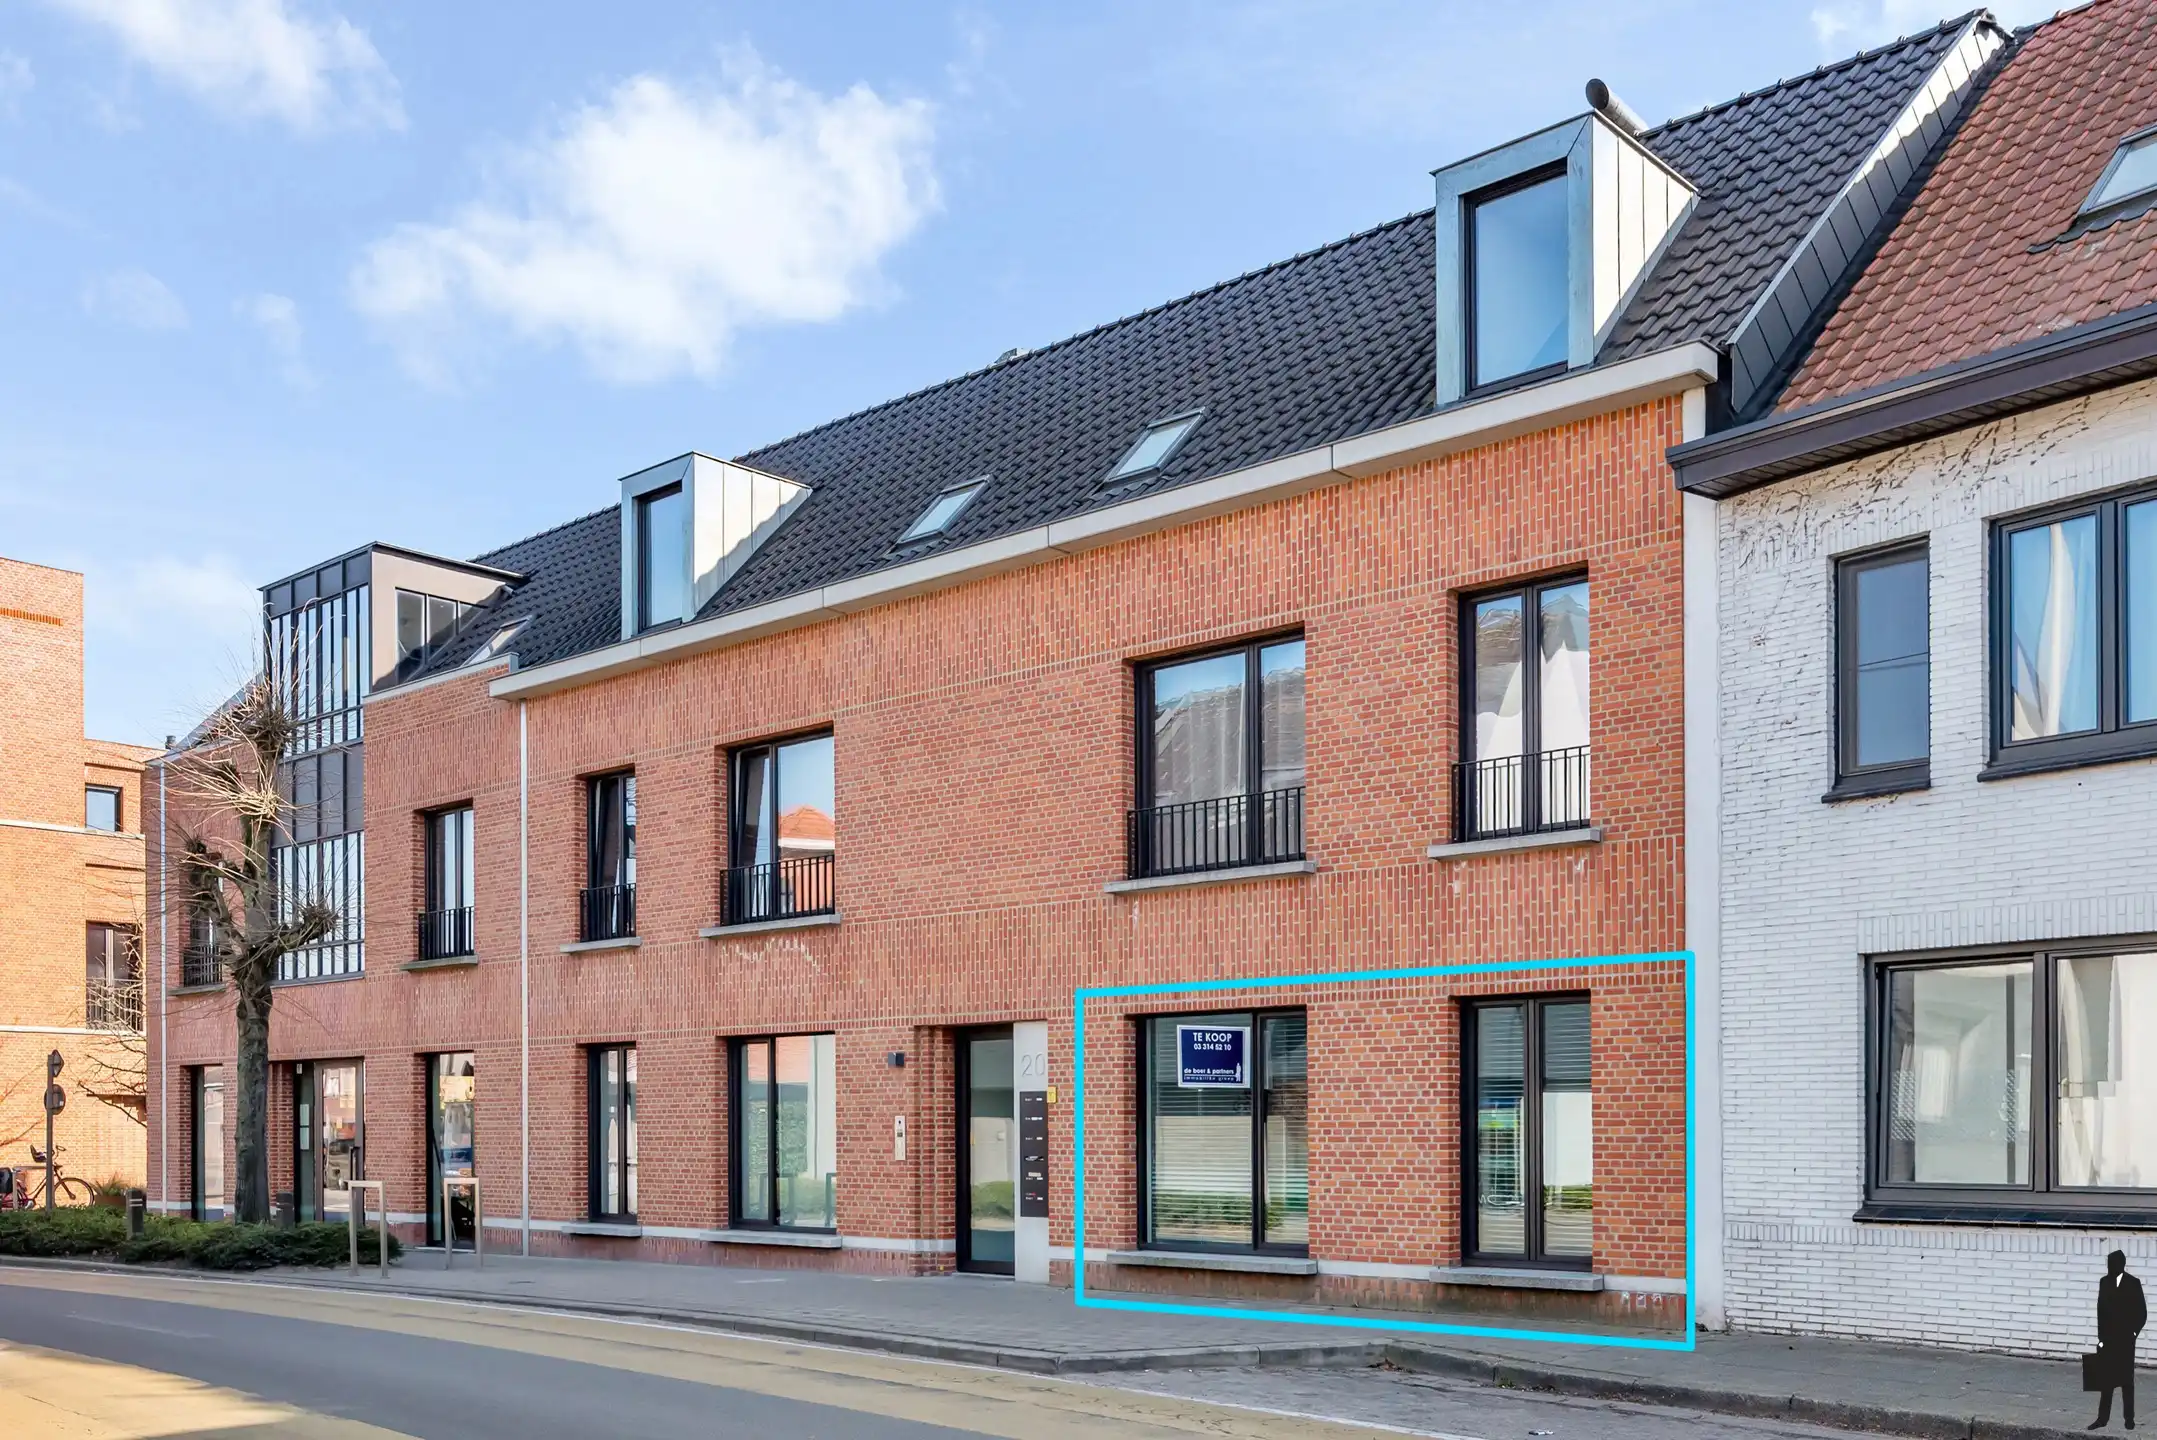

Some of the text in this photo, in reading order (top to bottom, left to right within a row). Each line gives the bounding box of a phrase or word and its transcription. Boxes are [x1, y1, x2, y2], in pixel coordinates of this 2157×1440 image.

[1192, 1032, 1232, 1042] TE KOOP
[1021, 1052, 1045, 1077] 20
